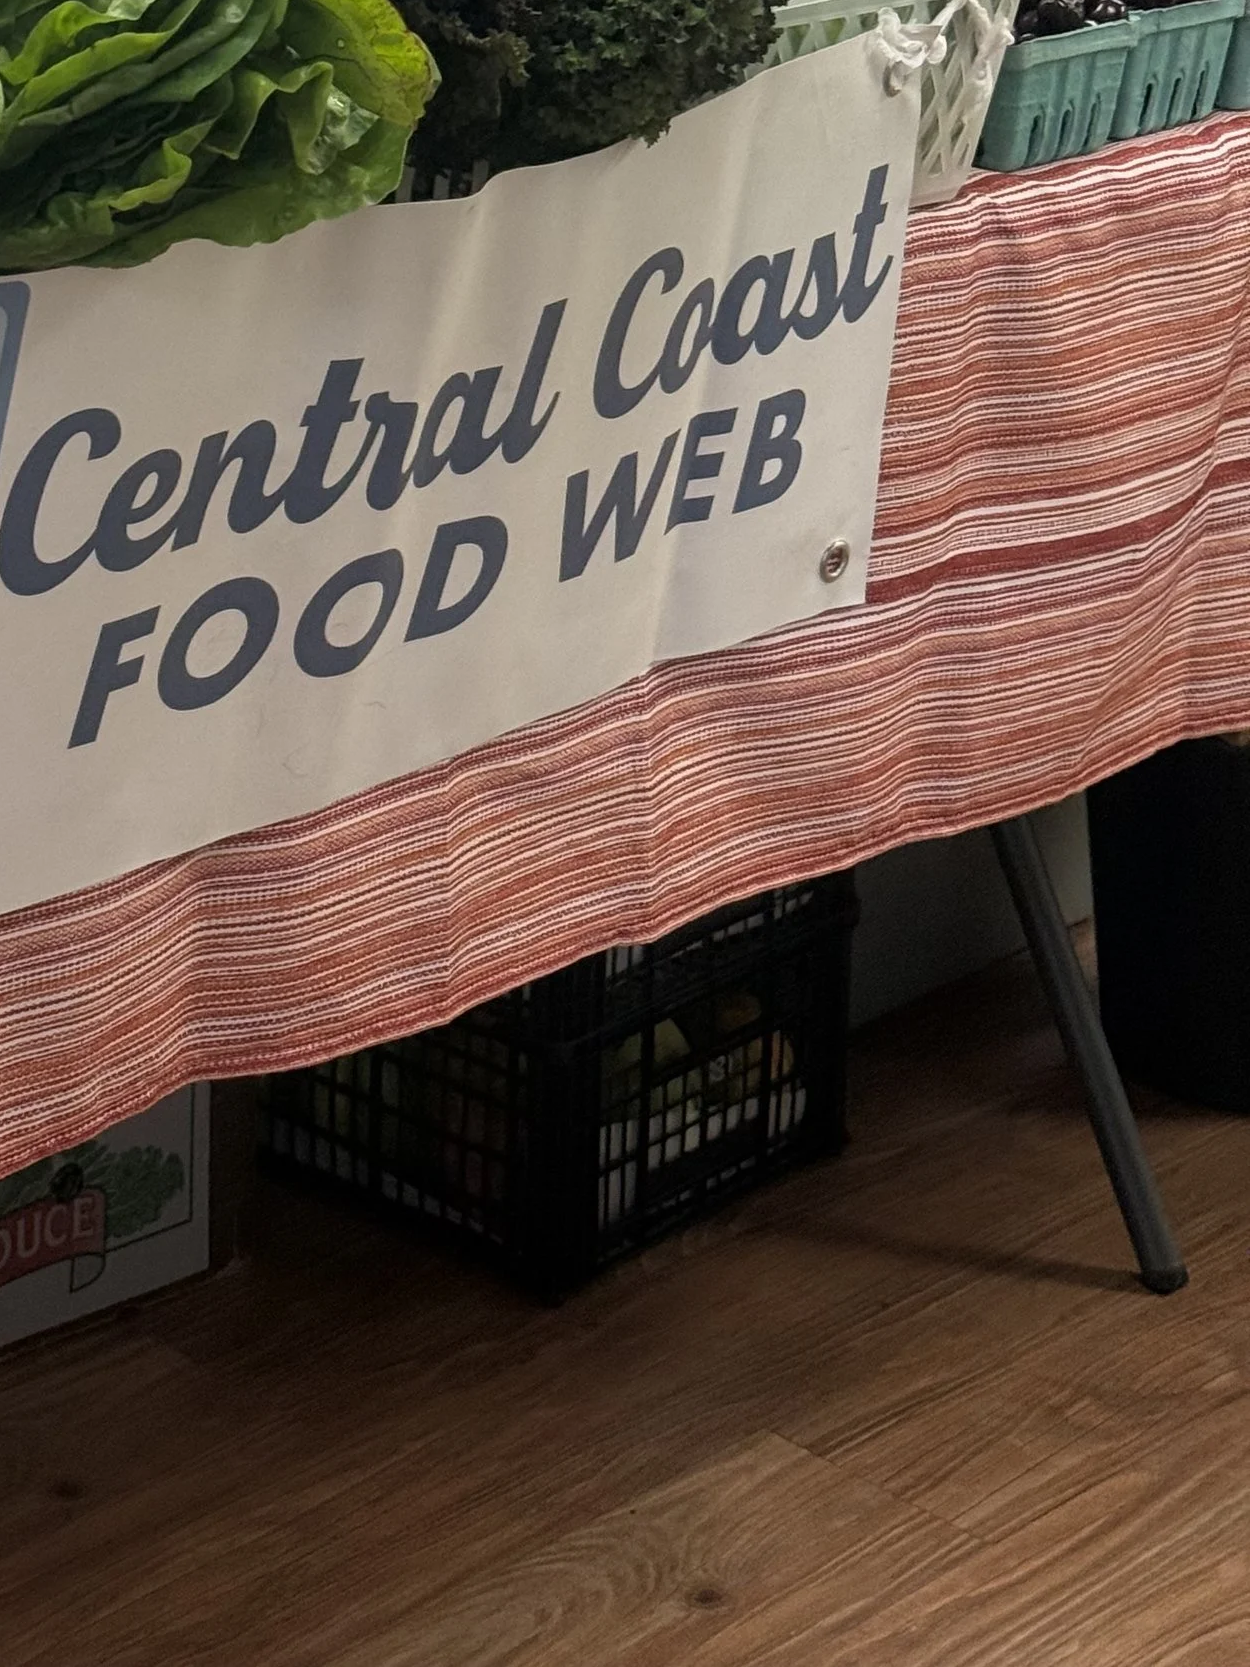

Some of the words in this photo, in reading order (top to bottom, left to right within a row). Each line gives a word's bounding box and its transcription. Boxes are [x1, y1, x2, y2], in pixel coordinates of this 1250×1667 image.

[593, 163, 894, 419] Coast
[67, 515, 508, 749] FOOD
[558, 388, 806, 583] WEB
